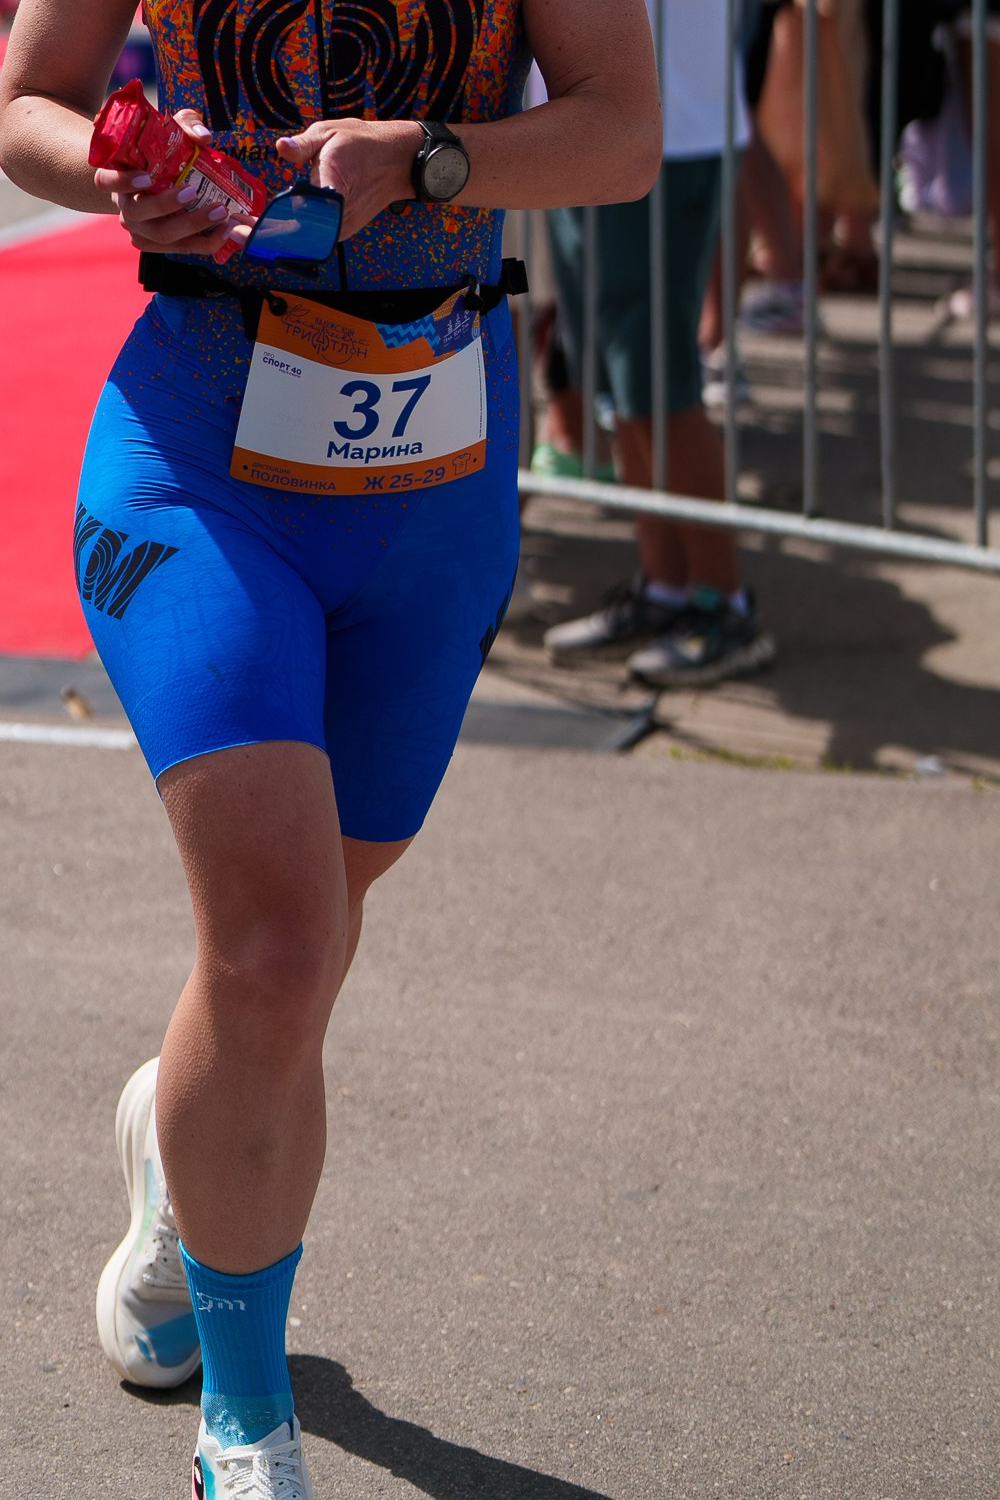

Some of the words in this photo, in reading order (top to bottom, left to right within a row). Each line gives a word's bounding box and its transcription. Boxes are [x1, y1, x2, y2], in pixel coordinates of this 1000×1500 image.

[262, 356, 291, 372] СПОРТ
[290, 367, 302, 376] 40
[333, 374, 431, 440] 37
[326, 441, 423, 464] Марина
[250, 468, 337, 491] ПОЛОВИНКА
[362, 476, 385, 491] Ж
[389, 466, 446, 489] 25-29
